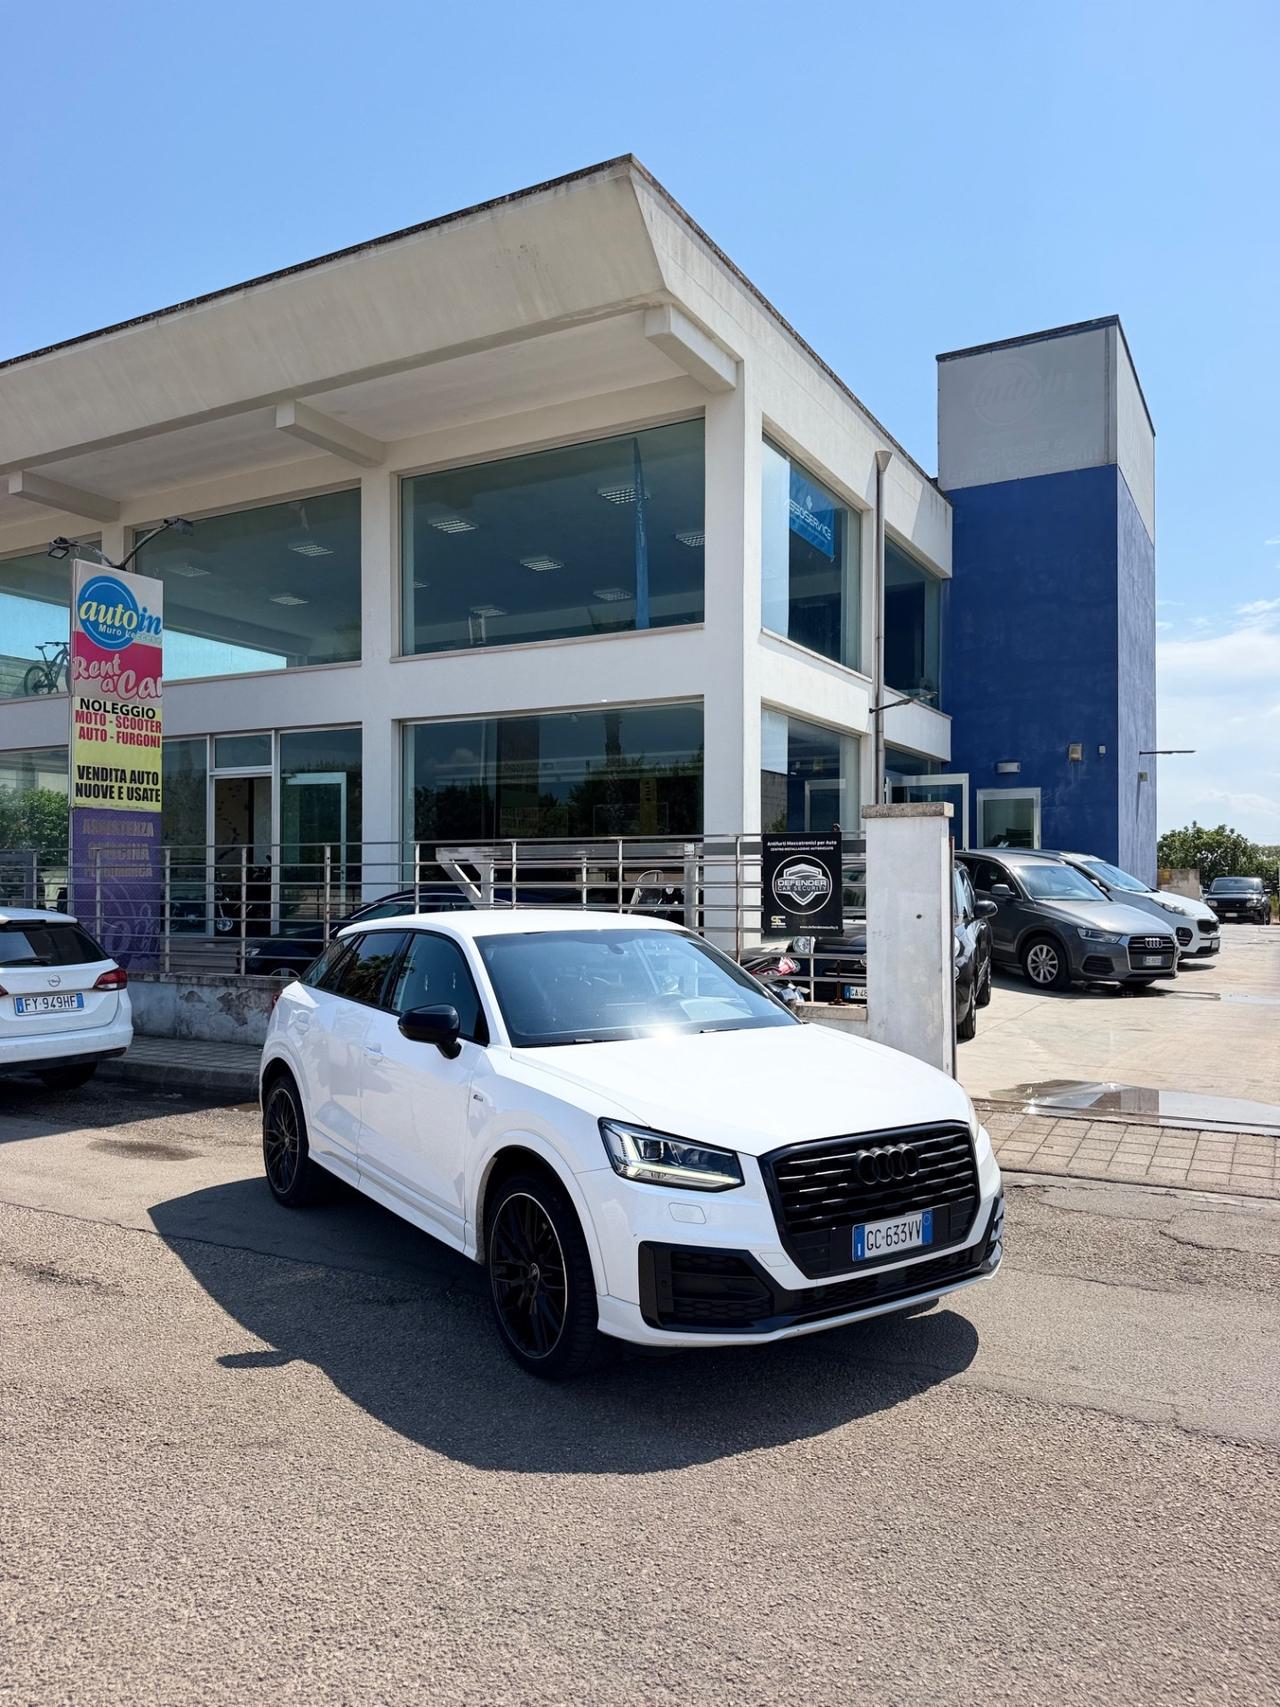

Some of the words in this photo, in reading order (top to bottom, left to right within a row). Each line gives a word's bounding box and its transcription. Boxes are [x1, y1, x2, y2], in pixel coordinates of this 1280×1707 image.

[99, 624, 122, 636] Muro
[72, 653, 121, 679] Rent
[80, 698, 156, 719] NOLEGGIO
[75, 710, 107, 726] MOTO
[116, 715, 162, 733] SCOOTER
[79, 726, 107, 742] AUTO
[116, 731, 161, 748] FURGONI
[77, 765, 127, 783] VENDITA
[129, 770, 159, 786] AUTO
[75, 782, 115, 799] NUOVE
[118, 786, 124, 800] E
[127, 787, 161, 802] USATE
